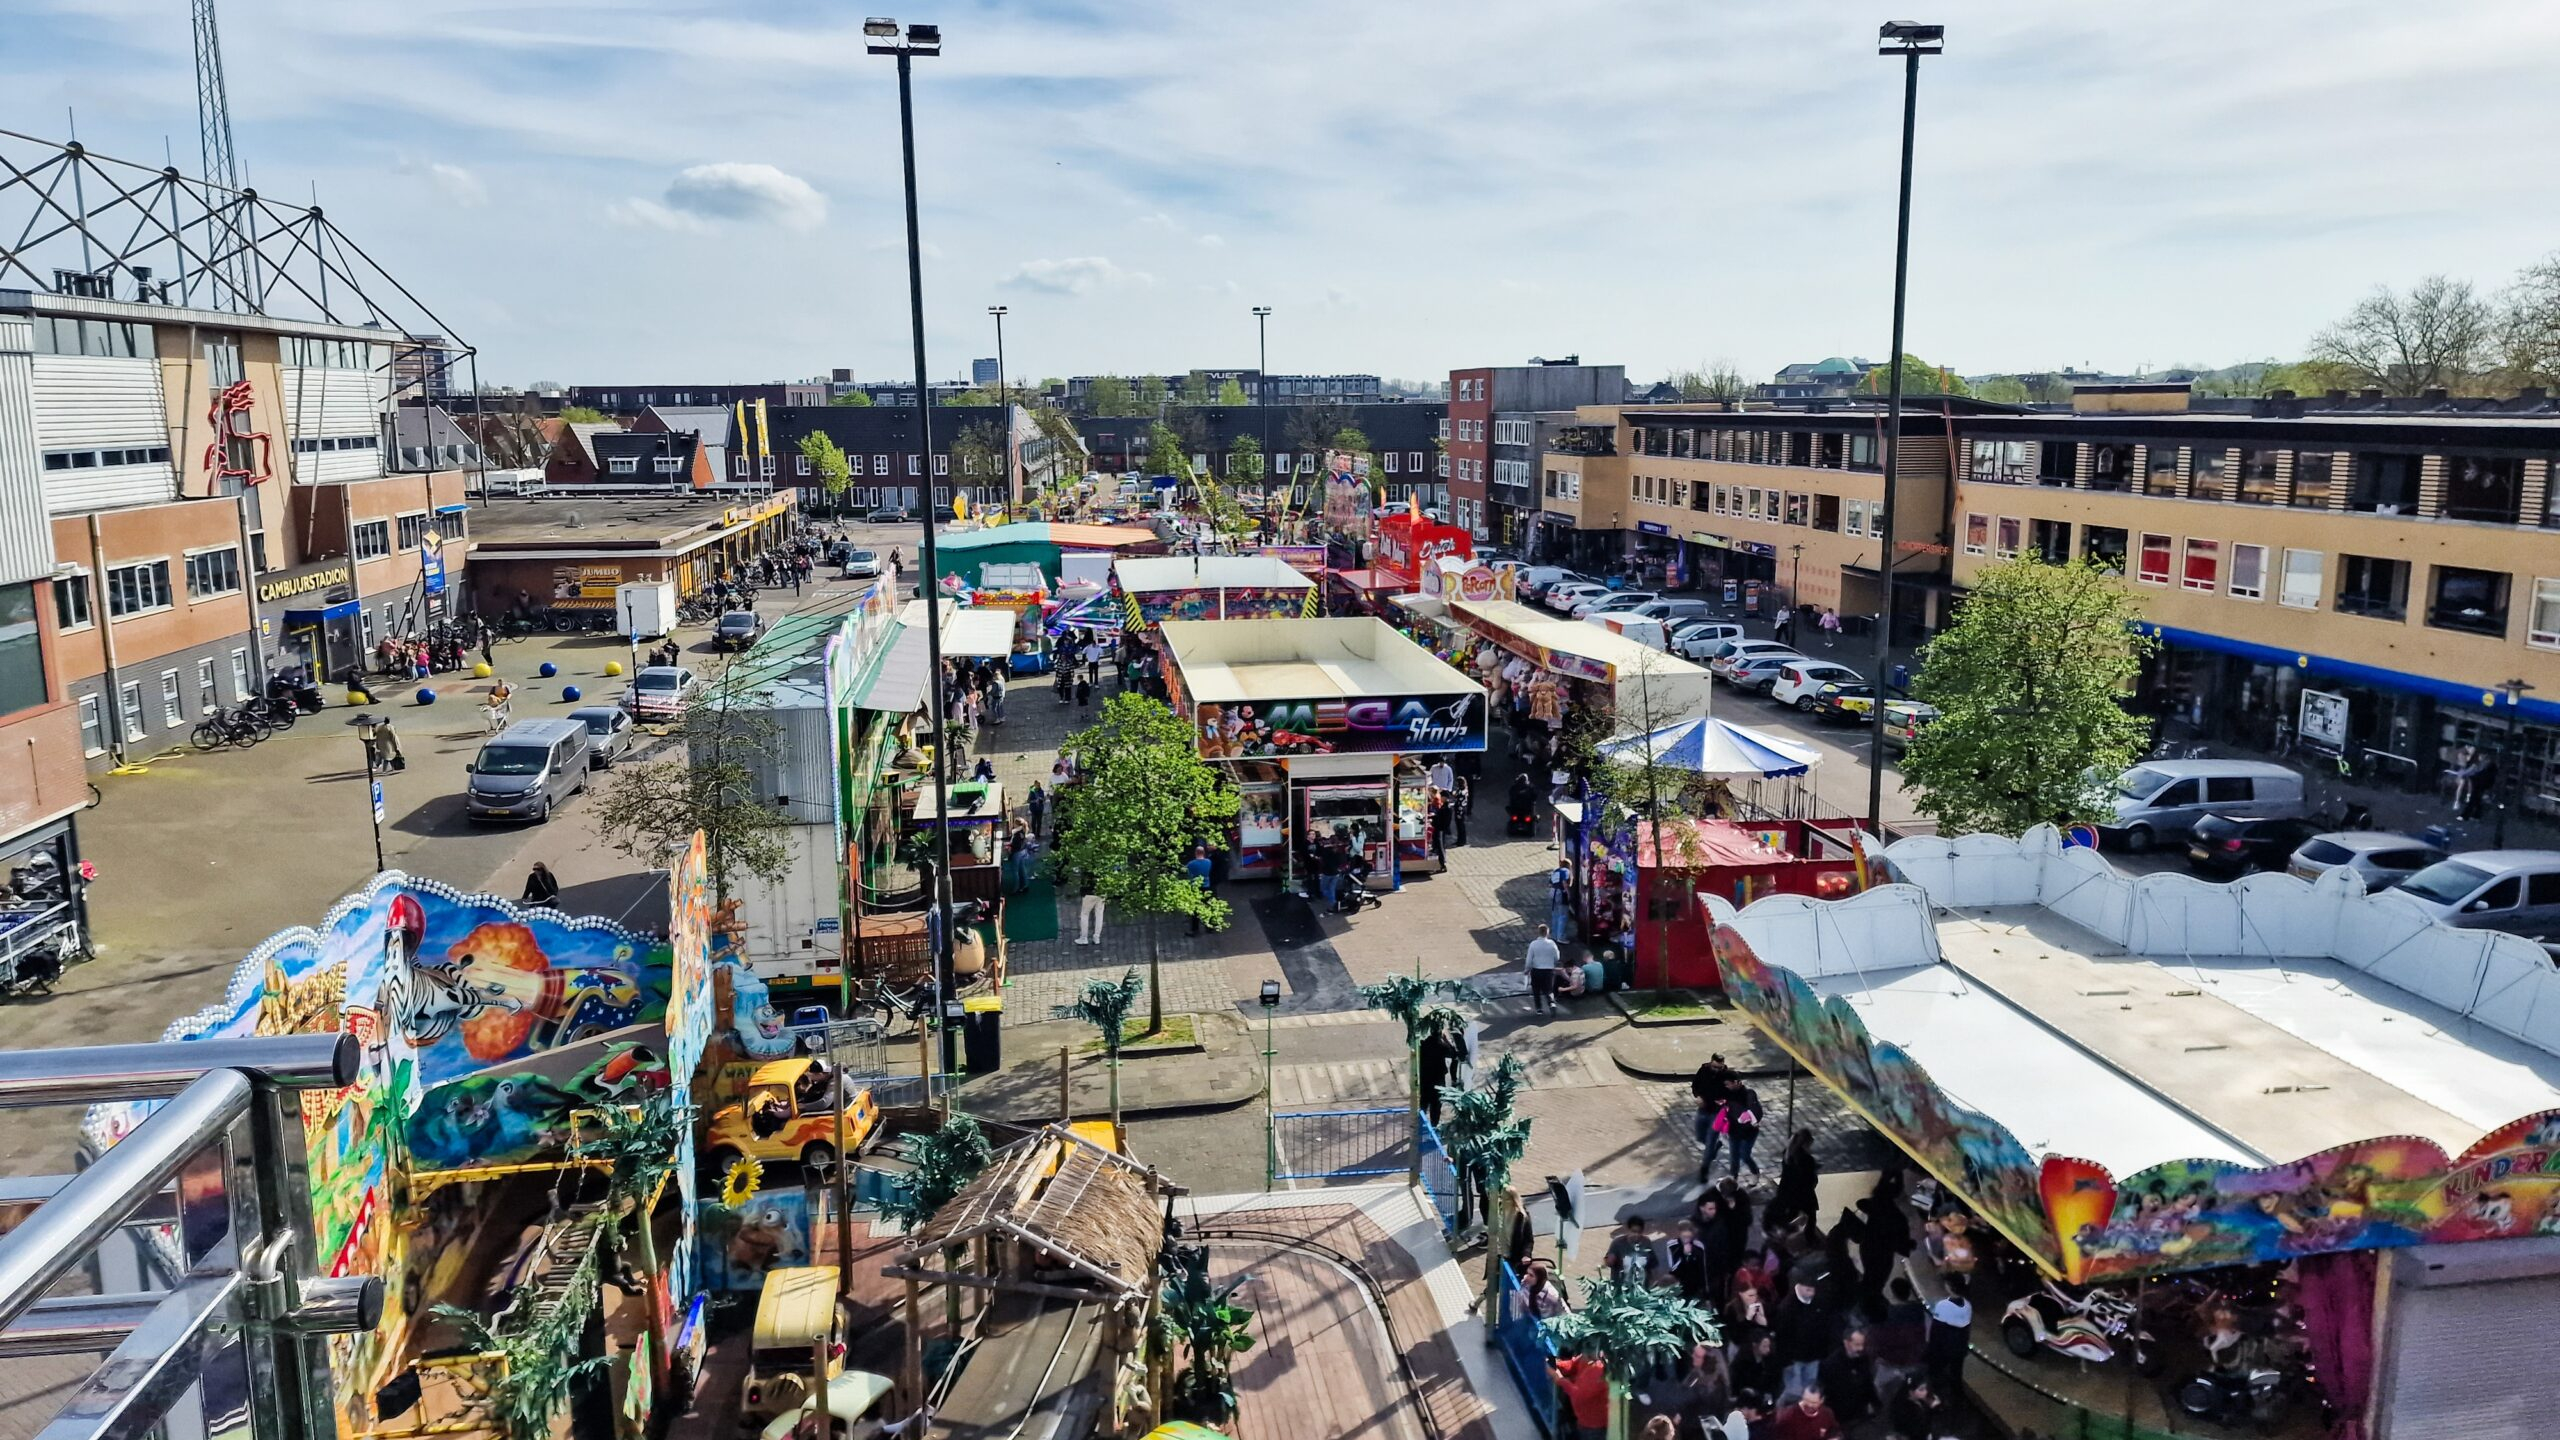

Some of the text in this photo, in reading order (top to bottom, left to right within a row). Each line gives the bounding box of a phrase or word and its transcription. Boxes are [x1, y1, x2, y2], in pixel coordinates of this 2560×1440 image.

[259, 567, 348, 602] CAMBUURSTADION
[582, 567, 620, 576] JUMBO
[1267, 701, 1467, 743] MEGA Store
[374, 784, 380, 801] P
